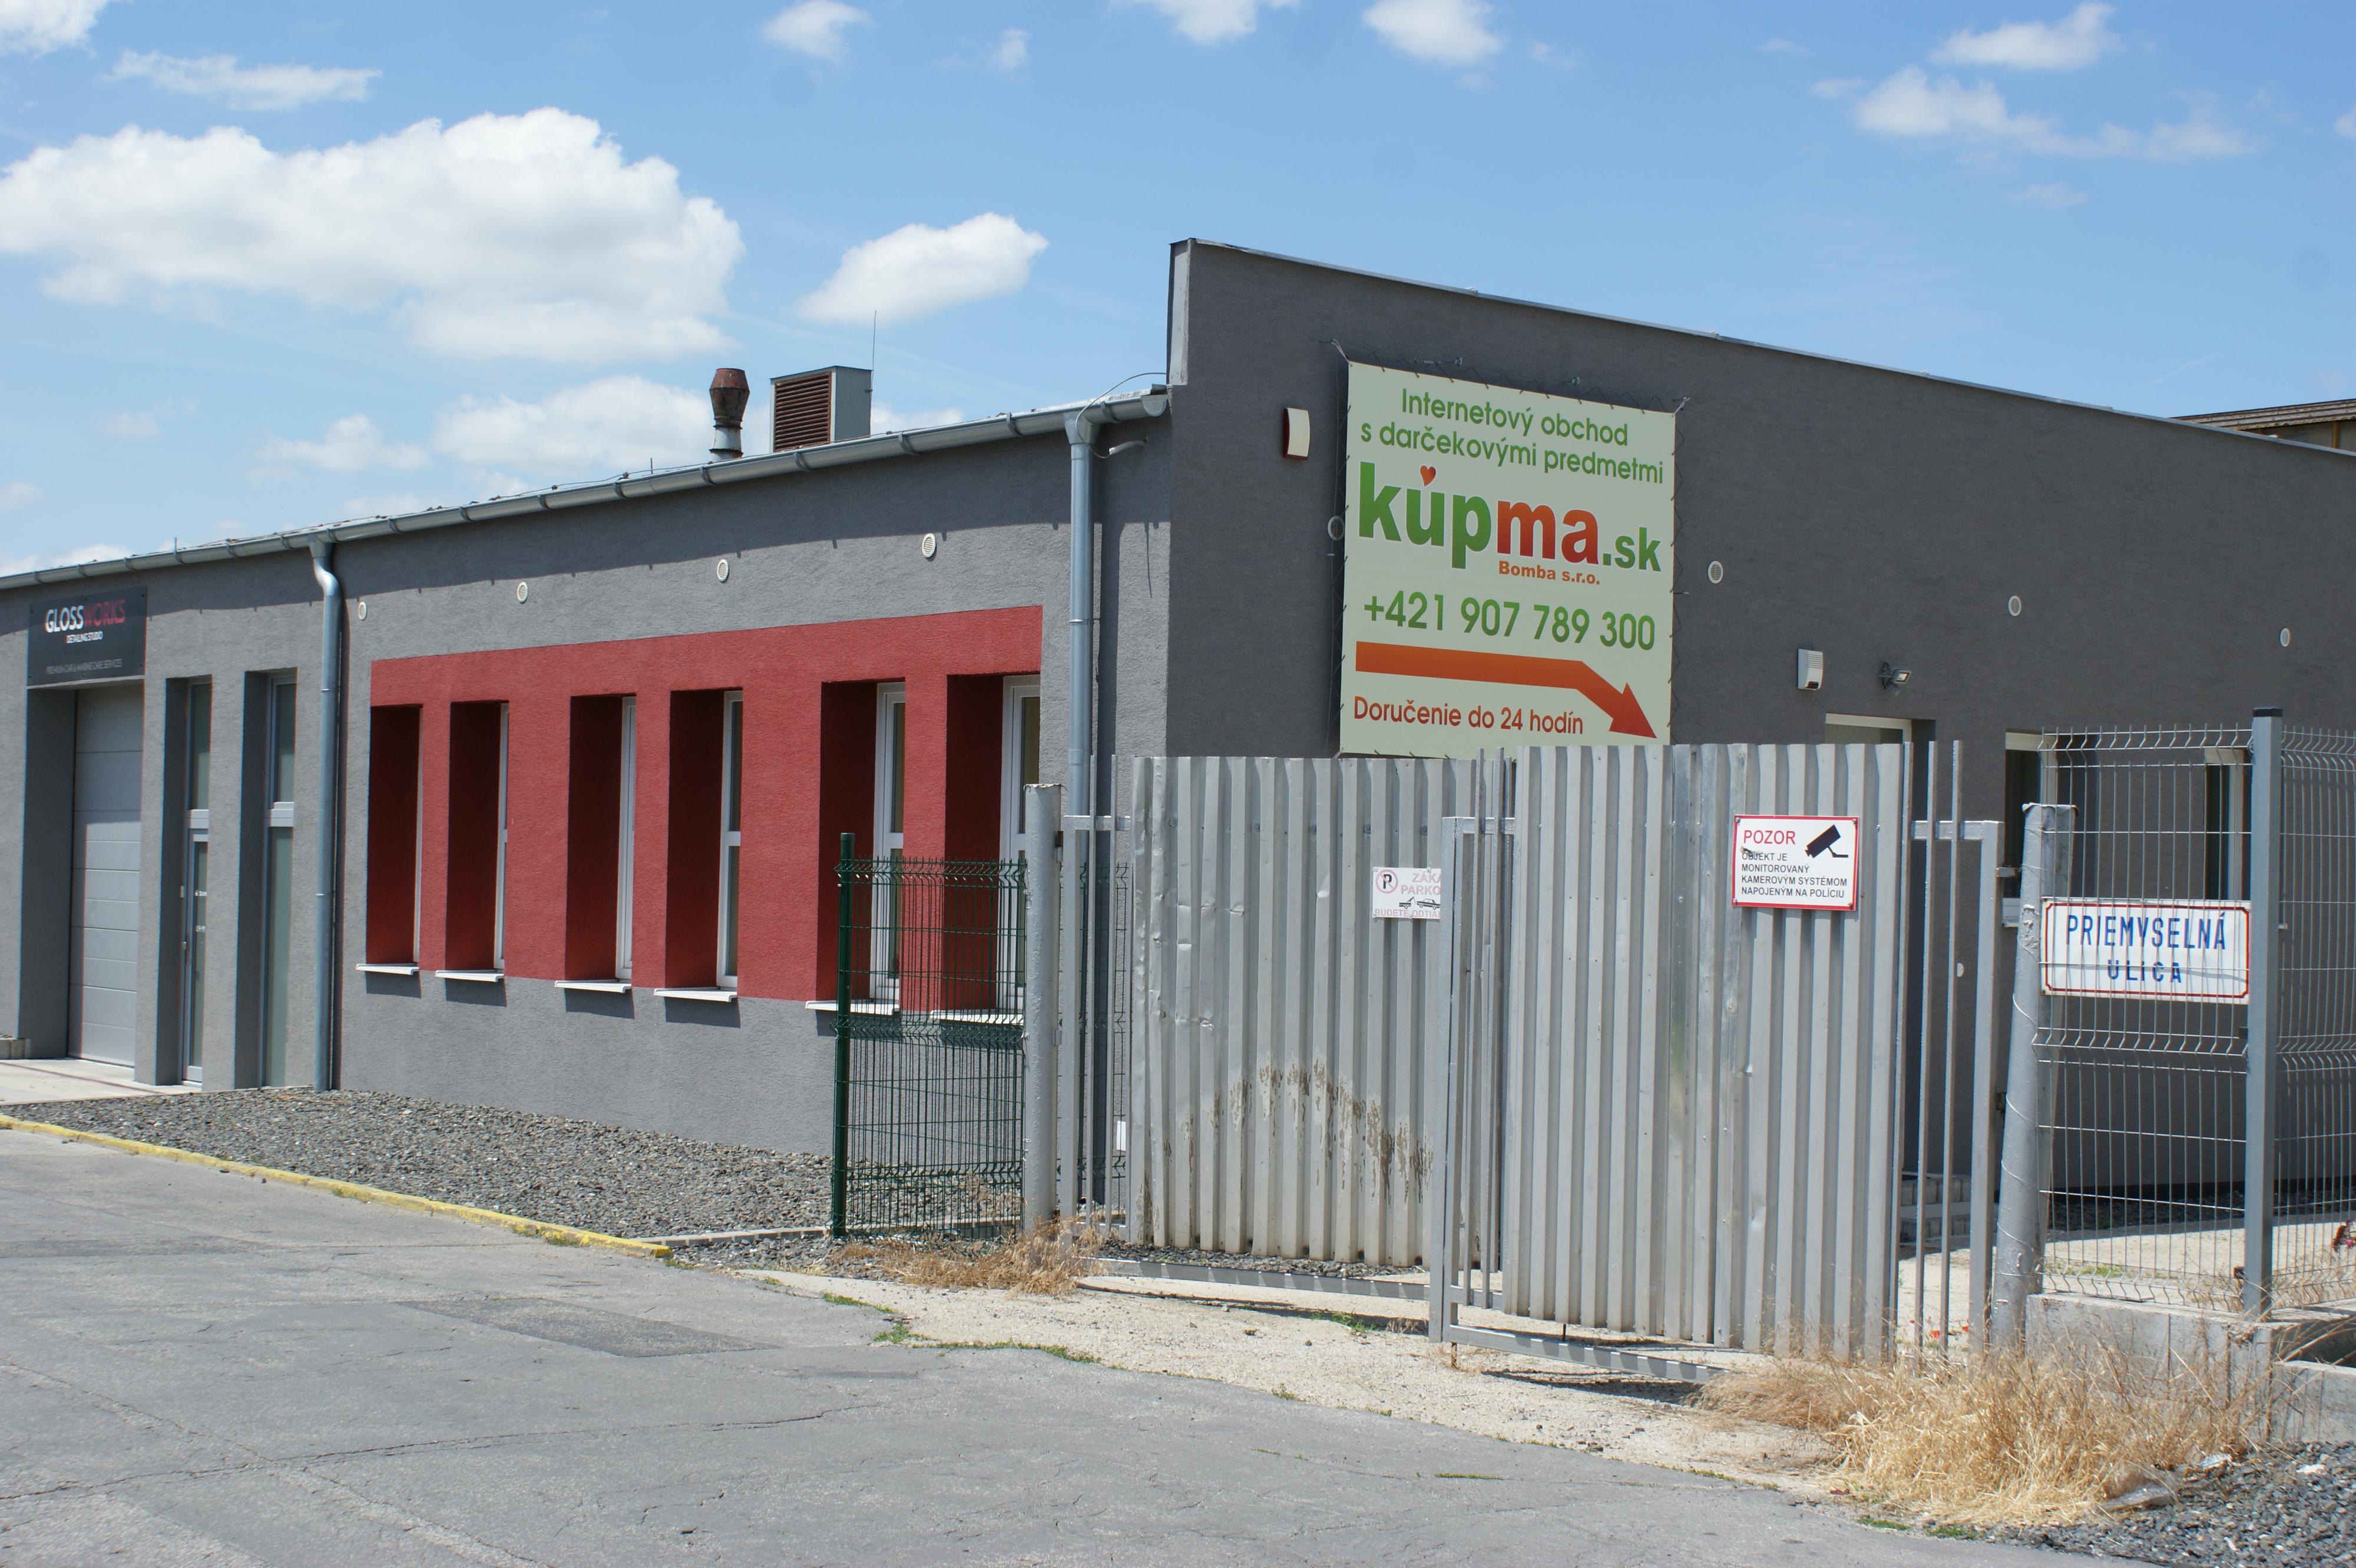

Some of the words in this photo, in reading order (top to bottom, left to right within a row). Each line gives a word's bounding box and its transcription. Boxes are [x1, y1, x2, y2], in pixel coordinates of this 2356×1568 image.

[1402, 388, 1534, 436] Internetový
[1541, 413, 1627, 446] obchod
[1361, 423, 1372, 442] s
[1379, 421, 1536, 467] darčekovými
[1544, 449, 1663, 484] predmetmi
[1498, 560, 1556, 580] Bomba
[1561, 570, 1600, 585] s.r.o.
[1364, 590, 1444, 631] +421
[1460, 597, 1520, 637] 907
[1533, 604, 1590, 643] 789
[1600, 611, 1655, 650] 300
[1354, 696, 1461, 726] Doručenie
[1468, 706, 1494, 729] do
[1500, 707, 1523, 730] 24
[1530, 709, 1583, 735] hodín
[1743, 829, 1796, 845] POZOR
[1741, 863, 1810, 874] MONITOROVANÝ
[1742, 852, 1775, 861] OBJEKT
[1777, 853, 1788, 861] JE
[1741, 875, 1796, 885] KAMEROVÝM
[1798, 876, 1847, 886] SYSTÉMOM
[1741, 886, 1793, 896] NAPOJENÝM
[1795, 888, 1807, 897] NA
[1810, 887, 1844, 898] POLÍCIU
[1375, 909, 1409, 917] BUDETE
[2066, 911, 2226, 950] PRIEMYSELNÁ
[2107, 959, 2182, 983] ULICA
